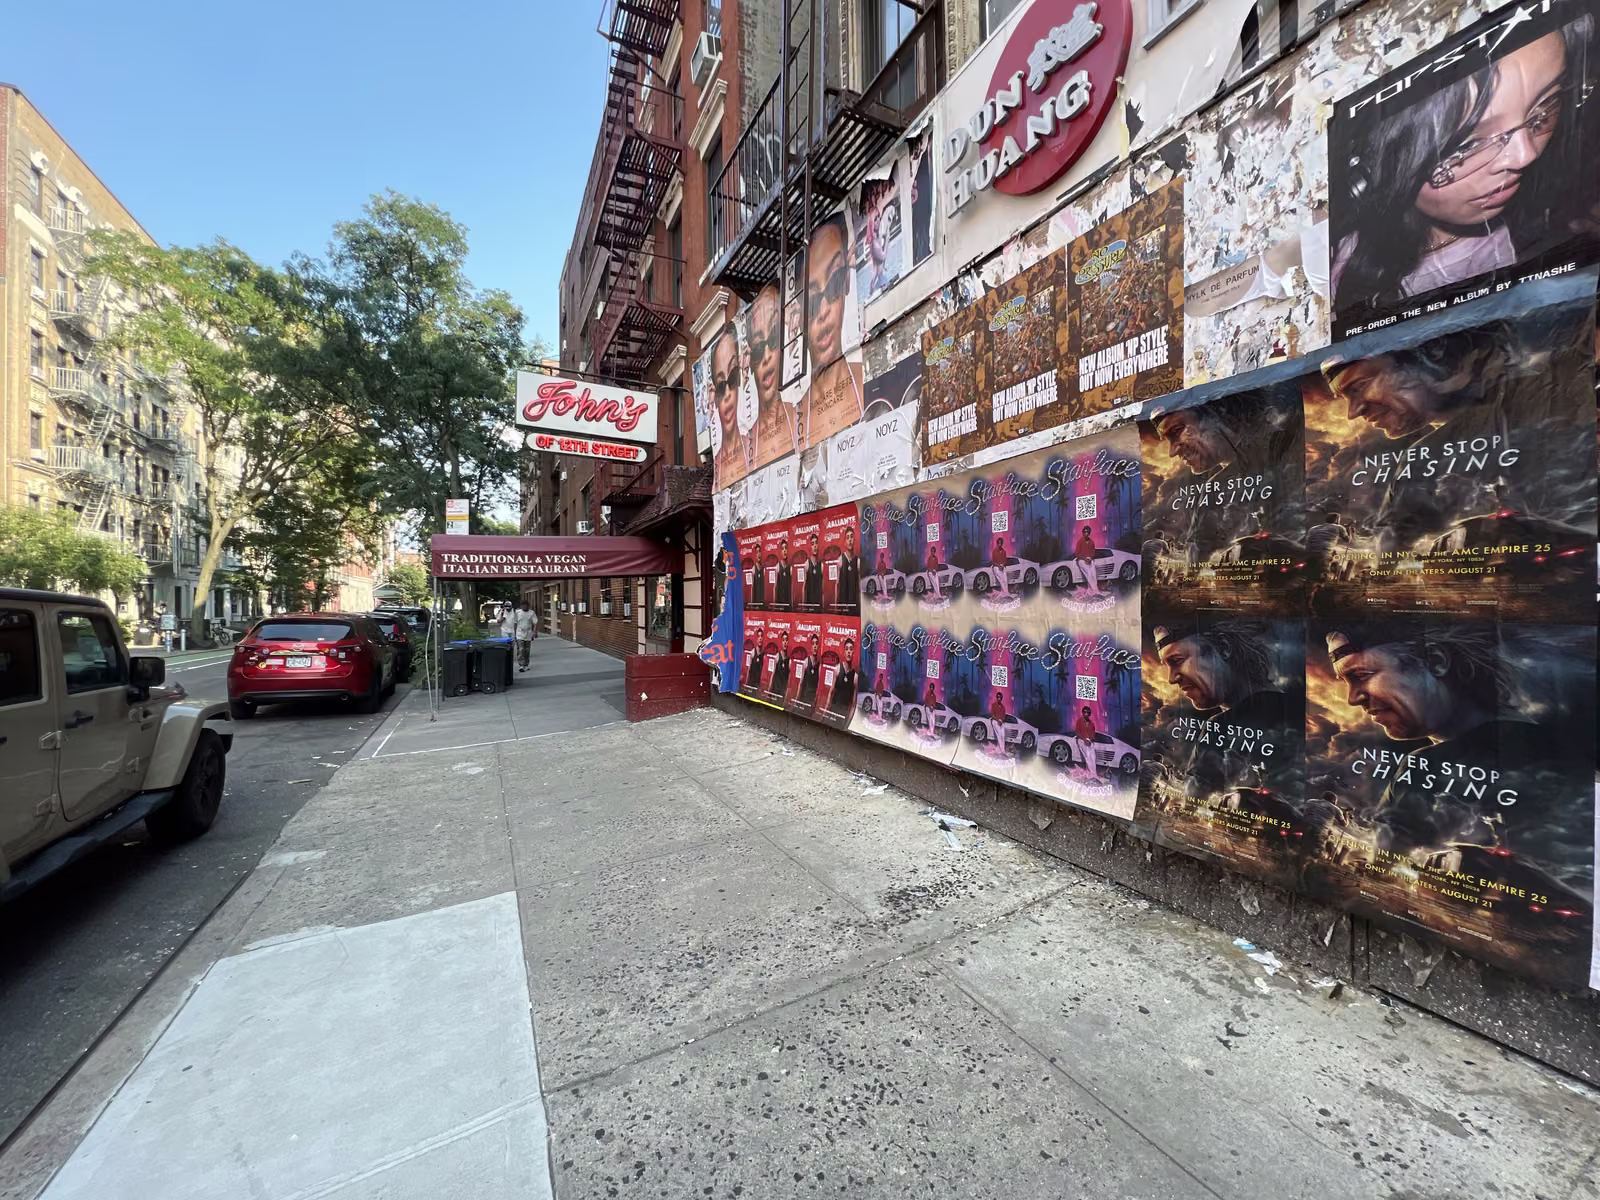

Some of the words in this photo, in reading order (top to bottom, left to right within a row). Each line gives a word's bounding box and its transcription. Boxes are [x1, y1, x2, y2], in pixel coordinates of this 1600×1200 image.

[942, 70, 1024, 173] DUN
[948, 70, 1092, 219] HUANG
[1210, 281, 1221, 293] DE
[1225, 264, 1260, 286] PARFUM
[1346, 316, 1397, 337] PRE-ORDER
[1402, 307, 1421, 319] THE
[1427, 299, 1447, 312] NEW
[1453, 286, 1489, 304] ALBUM
[1496, 280, 1511, 293] BY
[1079, 356, 1097, 376] NEW
[1098, 342, 1124, 371] ALBUM
[1079, 373, 1094, 392] OUT
[1095, 364, 1114, 387] NOW
[1114, 344, 1168, 379] EVERYWHERE
[523, 381, 648, 432] John's
[837, 436, 855, 453] NOYZ
[876, 419, 898, 438] NOYZ
[536, 434, 554, 449] OF
[557, 436, 589, 454] 12TH
[592, 442, 638, 459] STREET
[1364, 447, 1430, 469] NEVER
[1443, 435, 1502, 456] STOP
[1041, 449, 1141, 501] Starface
[1351, 448, 1520, 486] CHASING
[965, 473, 1040, 516] Starface
[1171, 485, 1273, 510] CHASING
[1179, 481, 1221, 496] NEVER
[1227, 475, 1263, 490] STOP
[442, 553, 532, 563] TRADITIONAL
[536, 555, 542, 563] &
[545, 555, 587, 563] VEGAN
[1333, 552, 1377, 561] OPENING
[1451, 547, 1480, 555] AMC
[1484, 545, 1529, 554] EMPIRE
[1534, 544, 1550, 553] 25
[442, 564, 499, 574] ITALIAN
[503, 564, 587, 574] RESTAURANT
[1087, 596, 1116, 613] NOW
[965, 629, 1040, 661] Starface
[1041, 633, 1142, 671] Starface
[1171, 726, 1274, 756] CHASING
[1179, 716, 1220, 733] NEVER
[1227, 724, 1264, 740] STOP
[1363, 747, 1429, 771] NEVER
[1441, 761, 1500, 784] STOP
[1083, 782, 1113, 796] NOW
[1351, 759, 1519, 806] CHASING
[1226, 822, 1250, 833] AUGUST
[1230, 808, 1248, 818] AMC
[1250, 813, 1278, 826] EMPIRE
[1281, 820, 1291, 829] 25
[1365, 863, 1386, 874] ONLY
[1388, 869, 1398, 877] IN
[1399, 872, 1437, 892] THEATERS
[1440, 888, 1479, 904] AUGUST
[1482, 900, 1492, 908] 21
[1377, 849, 1390, 858] IN
[1393, 853, 1414, 865] NYC
[1428, 866, 1441, 875] THE
[1446, 870, 1474, 884] AMC
[1479, 878, 1526, 898] EMPIRE
[1531, 893, 1548, 904] 25
